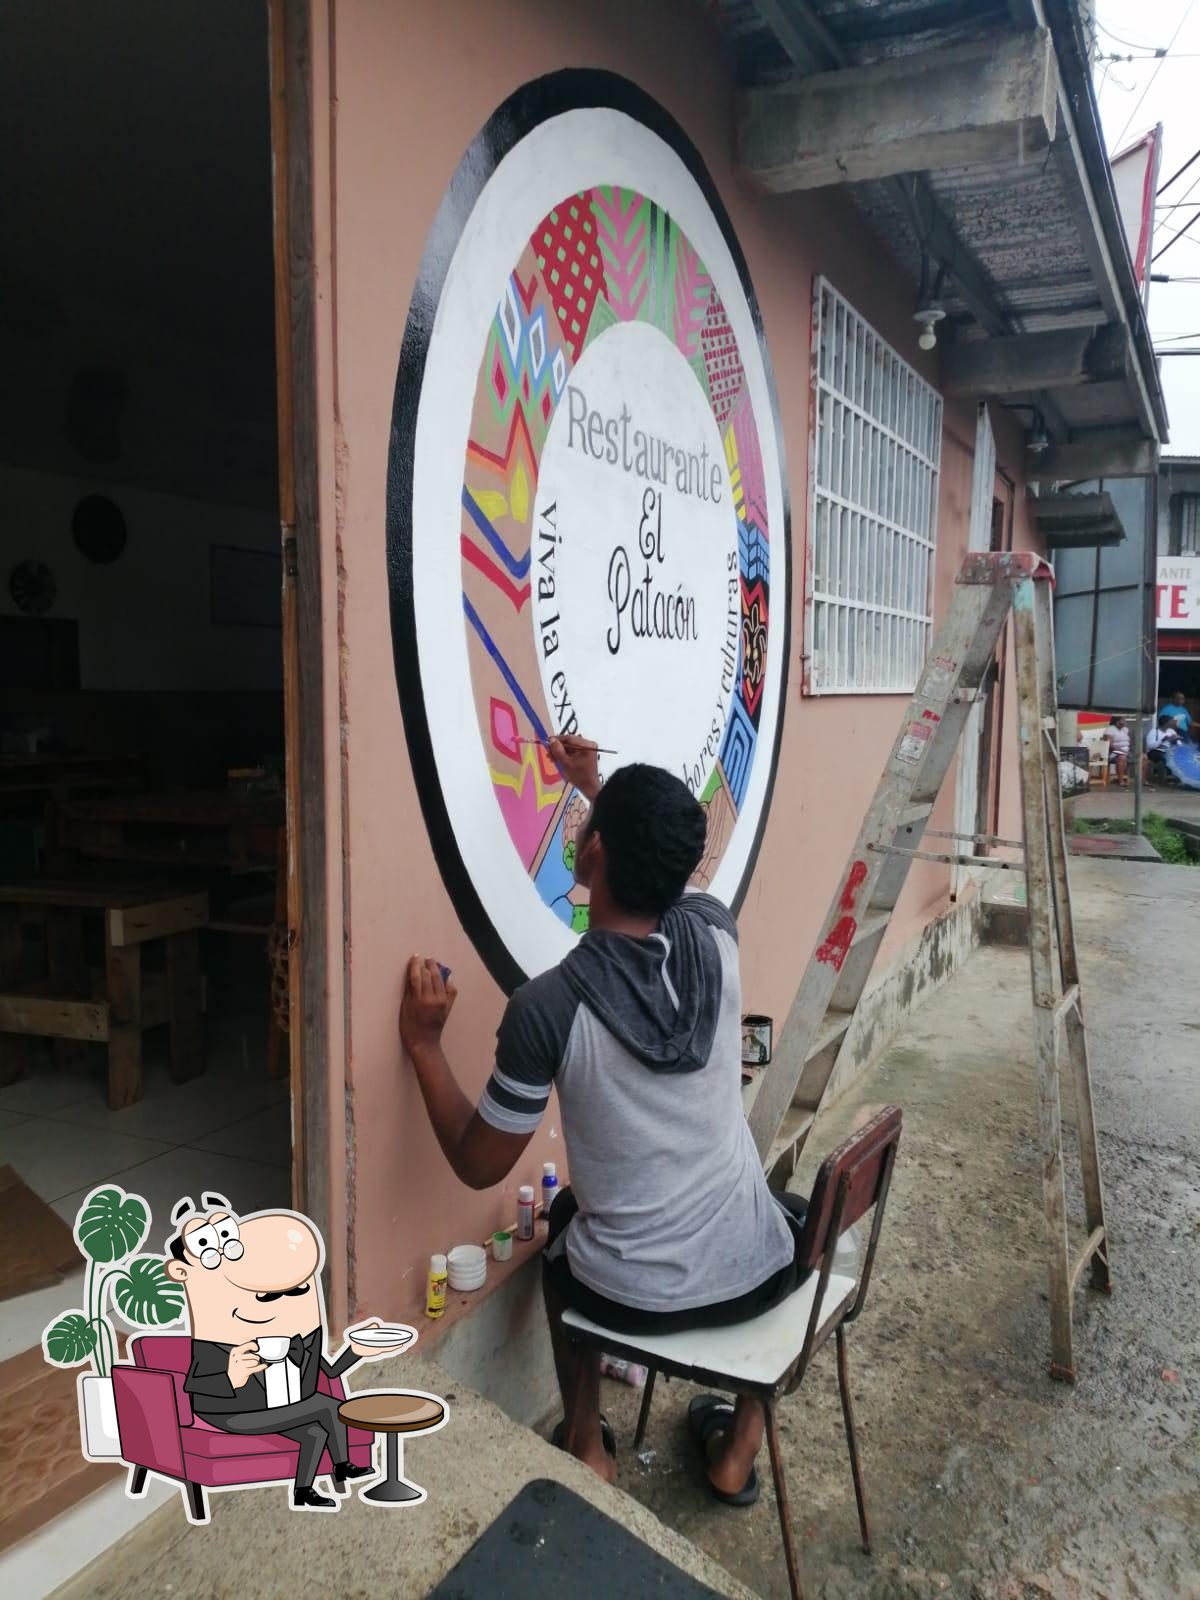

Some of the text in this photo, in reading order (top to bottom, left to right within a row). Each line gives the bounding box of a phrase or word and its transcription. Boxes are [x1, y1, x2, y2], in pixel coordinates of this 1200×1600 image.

[567, 385, 722, 504] Restaurante
[537, 500, 563, 603] viva
[638, 486, 665, 564] El
[540, 610, 561, 663] la
[606, 545, 698, 655] Patacón
[719, 551, 738, 694] culturas
[682, 717, 721, 797] bores
[716, 695, 727, 728] y
